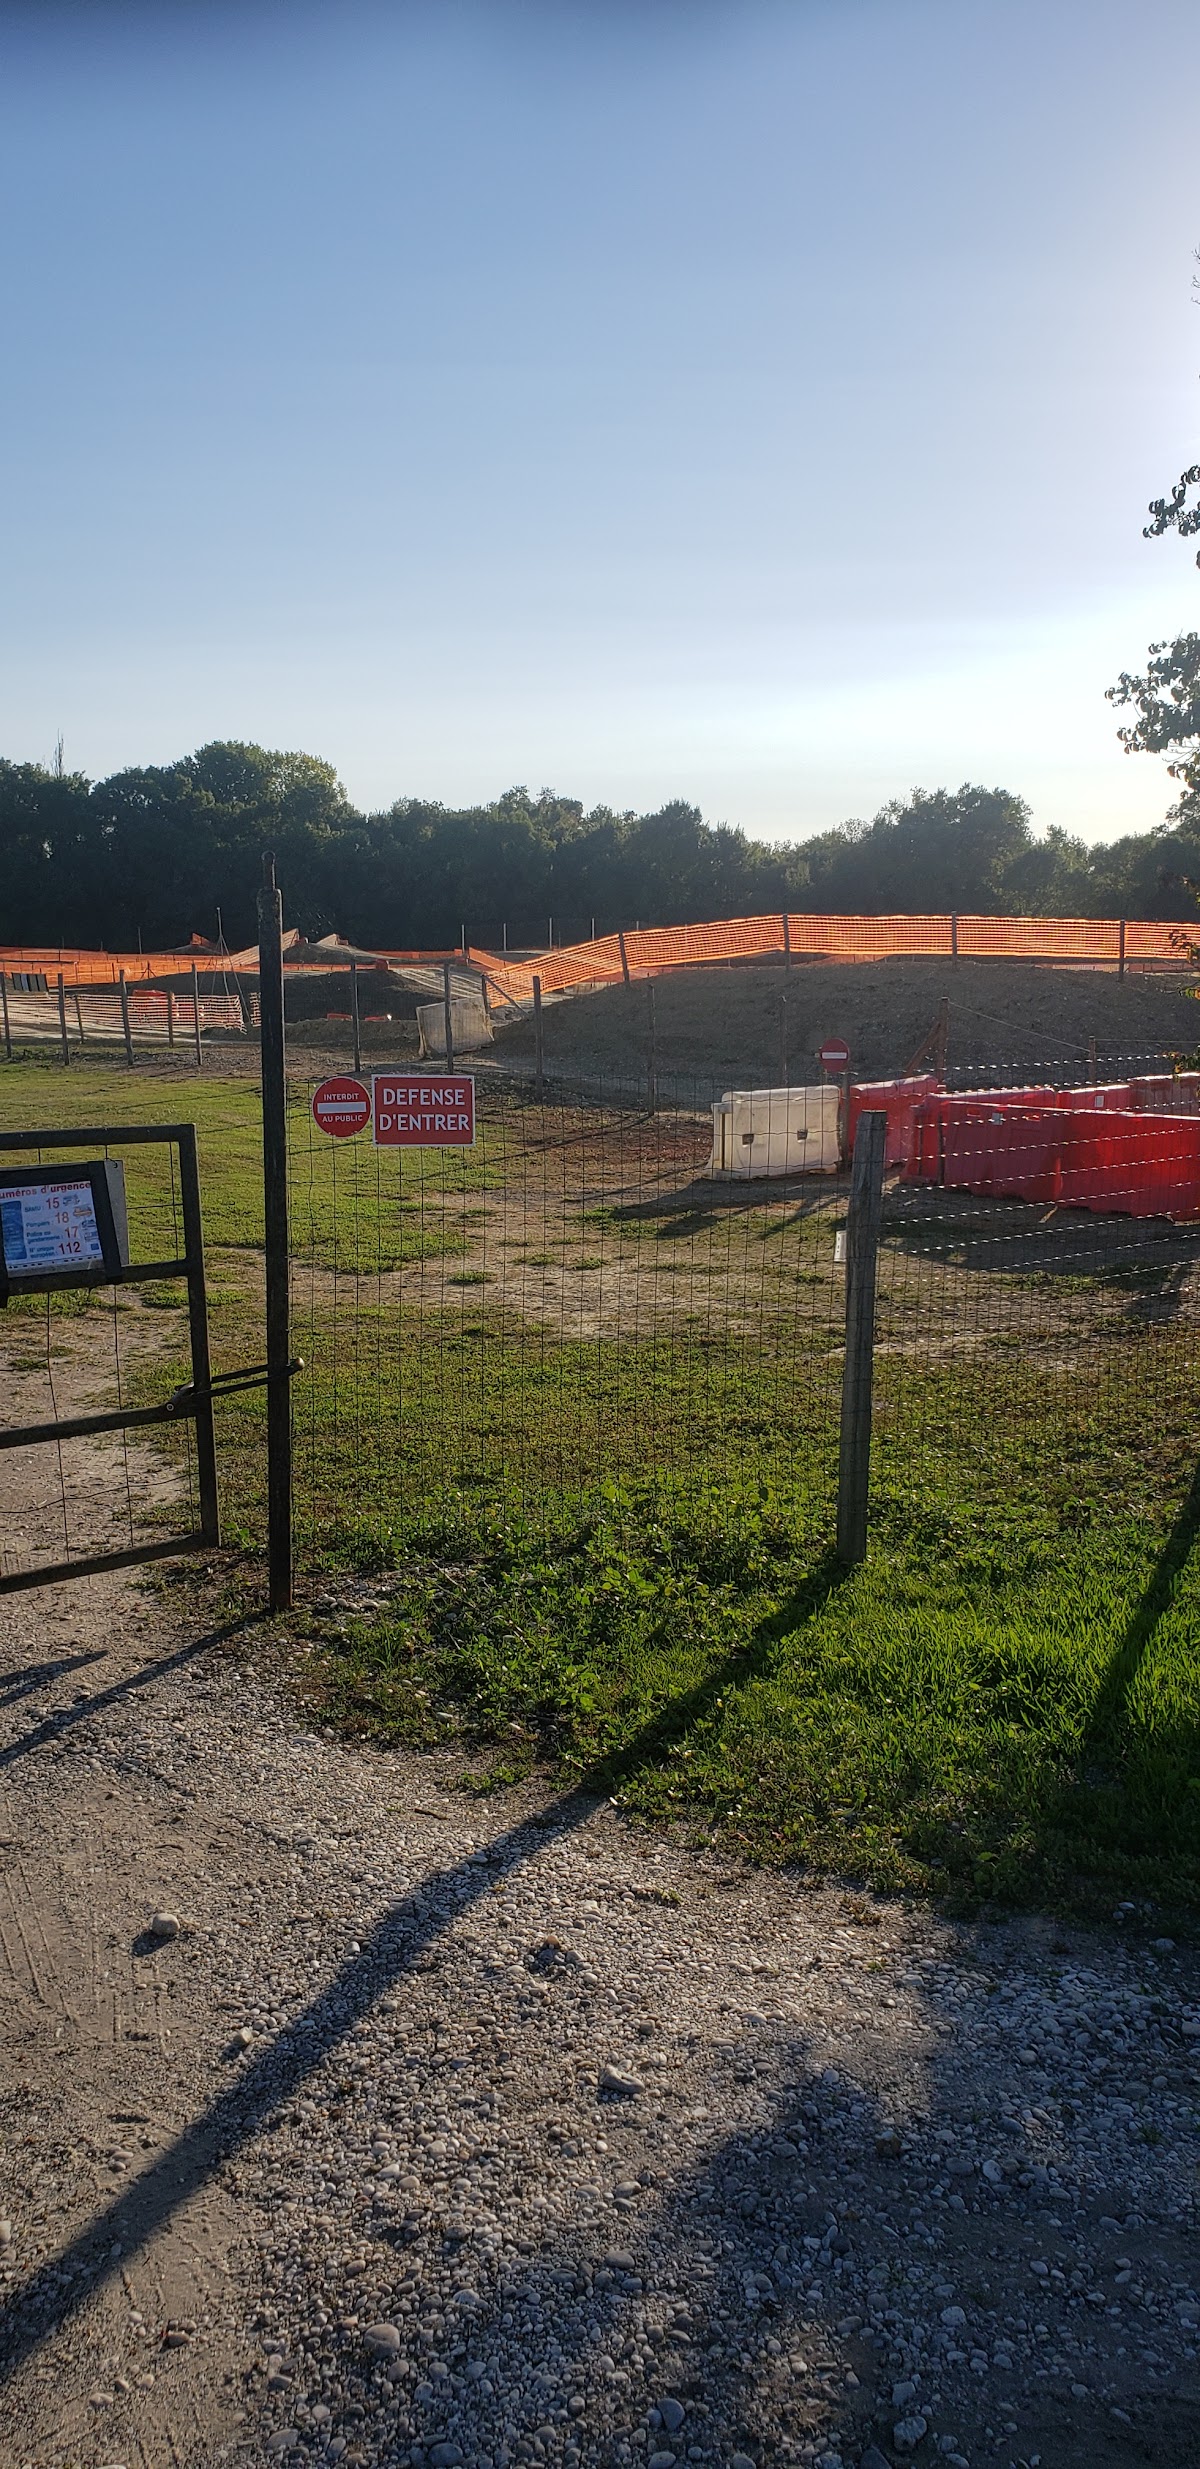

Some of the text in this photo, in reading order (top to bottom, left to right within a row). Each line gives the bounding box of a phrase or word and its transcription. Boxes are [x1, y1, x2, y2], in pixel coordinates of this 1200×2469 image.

[323, 1092, 360, 1101] INTERDIT
[383, 1088, 465, 1106] DEFENSE
[322, 1114, 363, 1123] AU PUBLIC
[379, 1113, 470, 1131] D'ENTRER
[0, 1182, 91, 1199] uméros d'urgence
[46, 1196, 60, 1209] 15
[55, 1211, 70, 1224] 18
[65, 1225, 79, 1239] 17
[58, 1241, 82, 1255] 112
